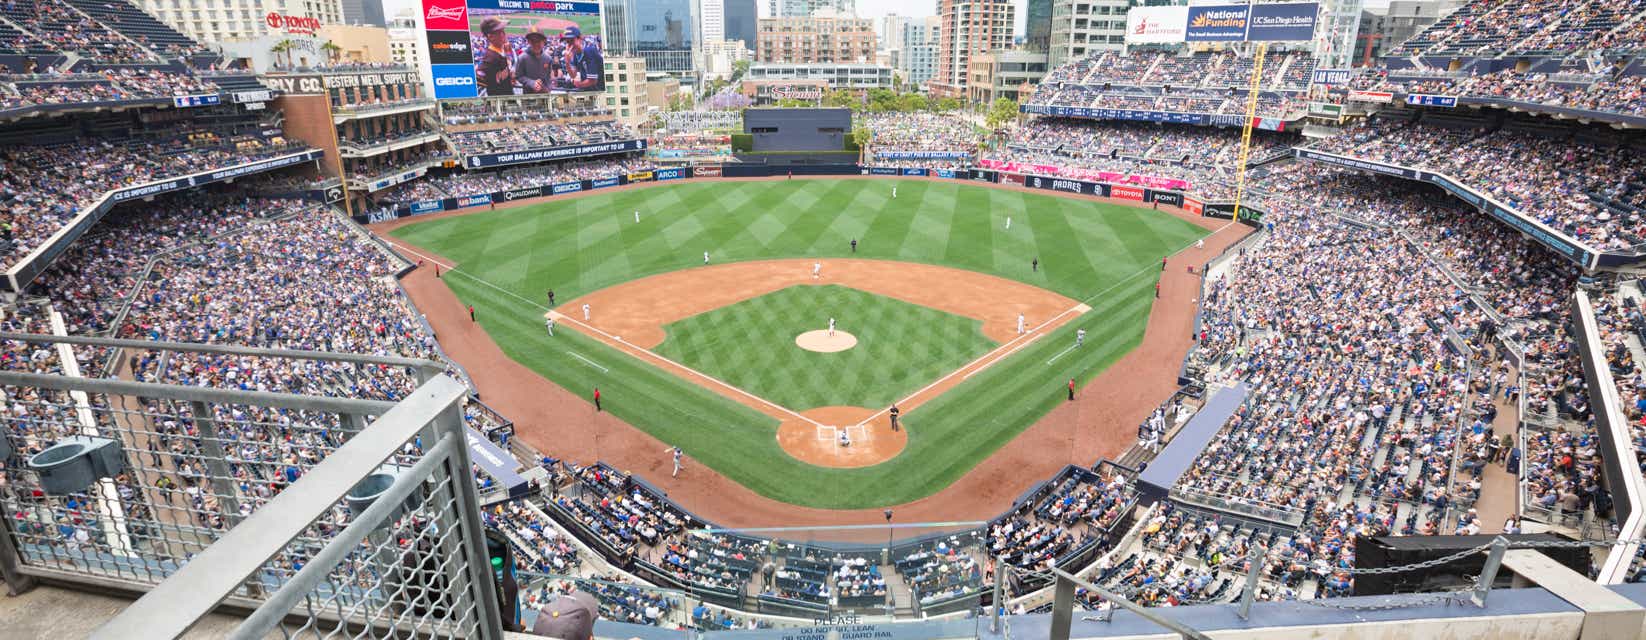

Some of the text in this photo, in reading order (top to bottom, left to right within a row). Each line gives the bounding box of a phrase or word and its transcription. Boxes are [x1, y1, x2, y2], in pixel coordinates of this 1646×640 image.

[1206, 9, 1246, 19] National
[284, 15, 321, 29] TOYOTA
[1205, 18, 1245, 29] Funding
[1253, 15, 1312, 26] UC San Diego Health
[325, 75, 360, 88] WESTERN
[361, 73, 383, 85] METAL
[383, 72, 406, 84] SUPPLY
[436, 77, 474, 86] GEICO
[1315, 71, 1348, 84] LAS VEGAS
[1209, 114, 1244, 127] PADRES
[497, 154, 514, 162] YOUR
[514, 151, 543, 160] BALLPARK
[543, 148, 575, 158] EXPERIENCE
[582, 144, 610, 153] IMPORTANT
[130, 185, 161, 197] IMPORTANT
[554, 183, 581, 193] GEICO
[1053, 180, 1082, 193] PADRES
[1120, 190, 1143, 198] TOYOTA
[814, 616, 863, 626] PLEASE
[842, 631, 872, 639] GUARD
